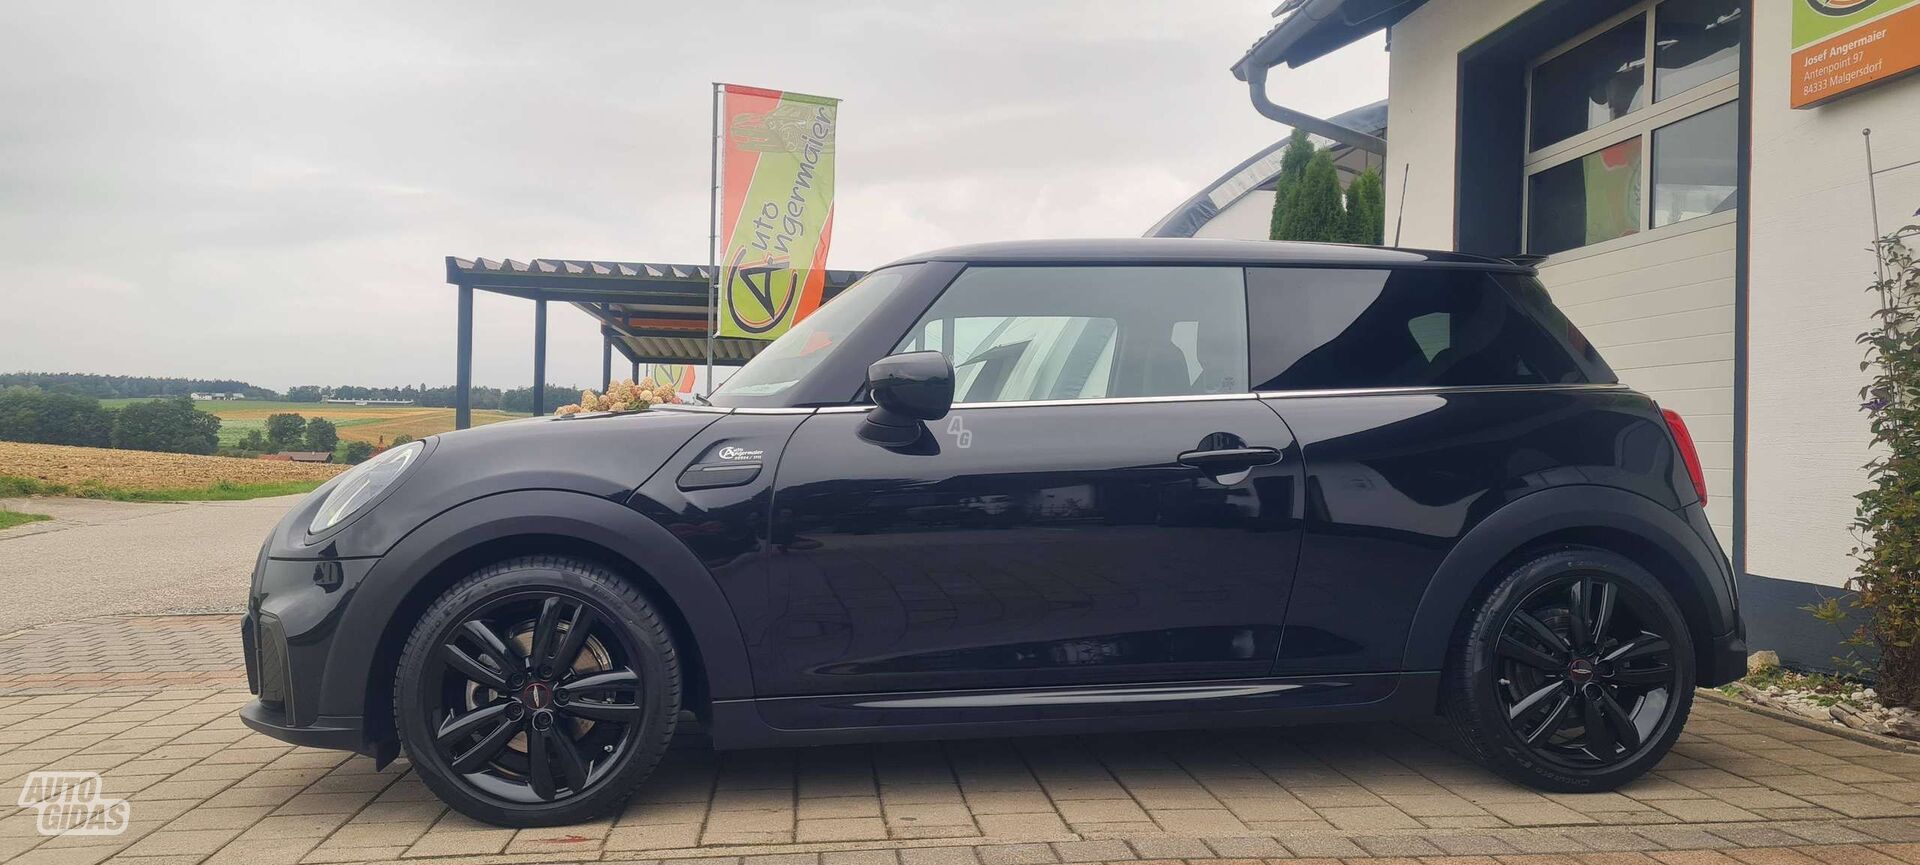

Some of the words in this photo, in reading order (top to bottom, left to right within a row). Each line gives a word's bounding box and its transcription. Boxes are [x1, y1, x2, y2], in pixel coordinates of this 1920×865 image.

[1803, 48, 1828, 67] Josef
[1829, 28, 1888, 57] Angermaier
[1803, 57, 1851, 81] Antenpoint
[1853, 51, 1864, 64] 97
[1803, 79, 1828, 96] 84333
[1829, 58, 1883, 88] Malgersdorf
